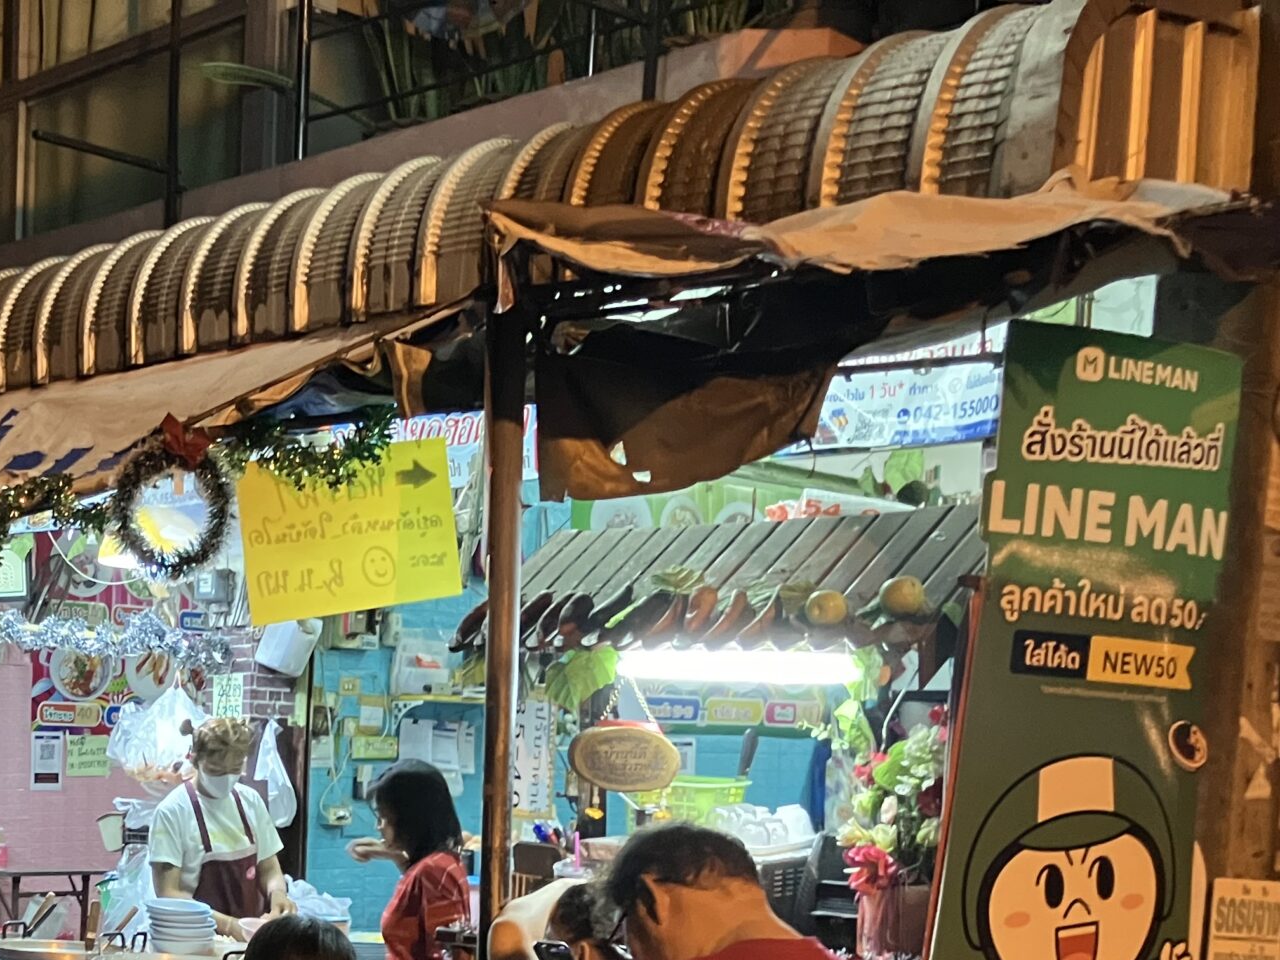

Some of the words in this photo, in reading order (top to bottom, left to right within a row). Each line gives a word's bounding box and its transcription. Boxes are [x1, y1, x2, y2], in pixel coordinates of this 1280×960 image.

[1023, 405, 1224, 472] สั่งร้านนี้ได้แล้วที่
[988, 480, 1117, 544] LINE
[1124, 495, 1228, 561] MAN
[1000, 578, 1122, 622] ลูกค้าใหม่
[1023, 638, 1081, 670] ใส่โค้ด
[1102, 650, 1178, 679] NEW50
